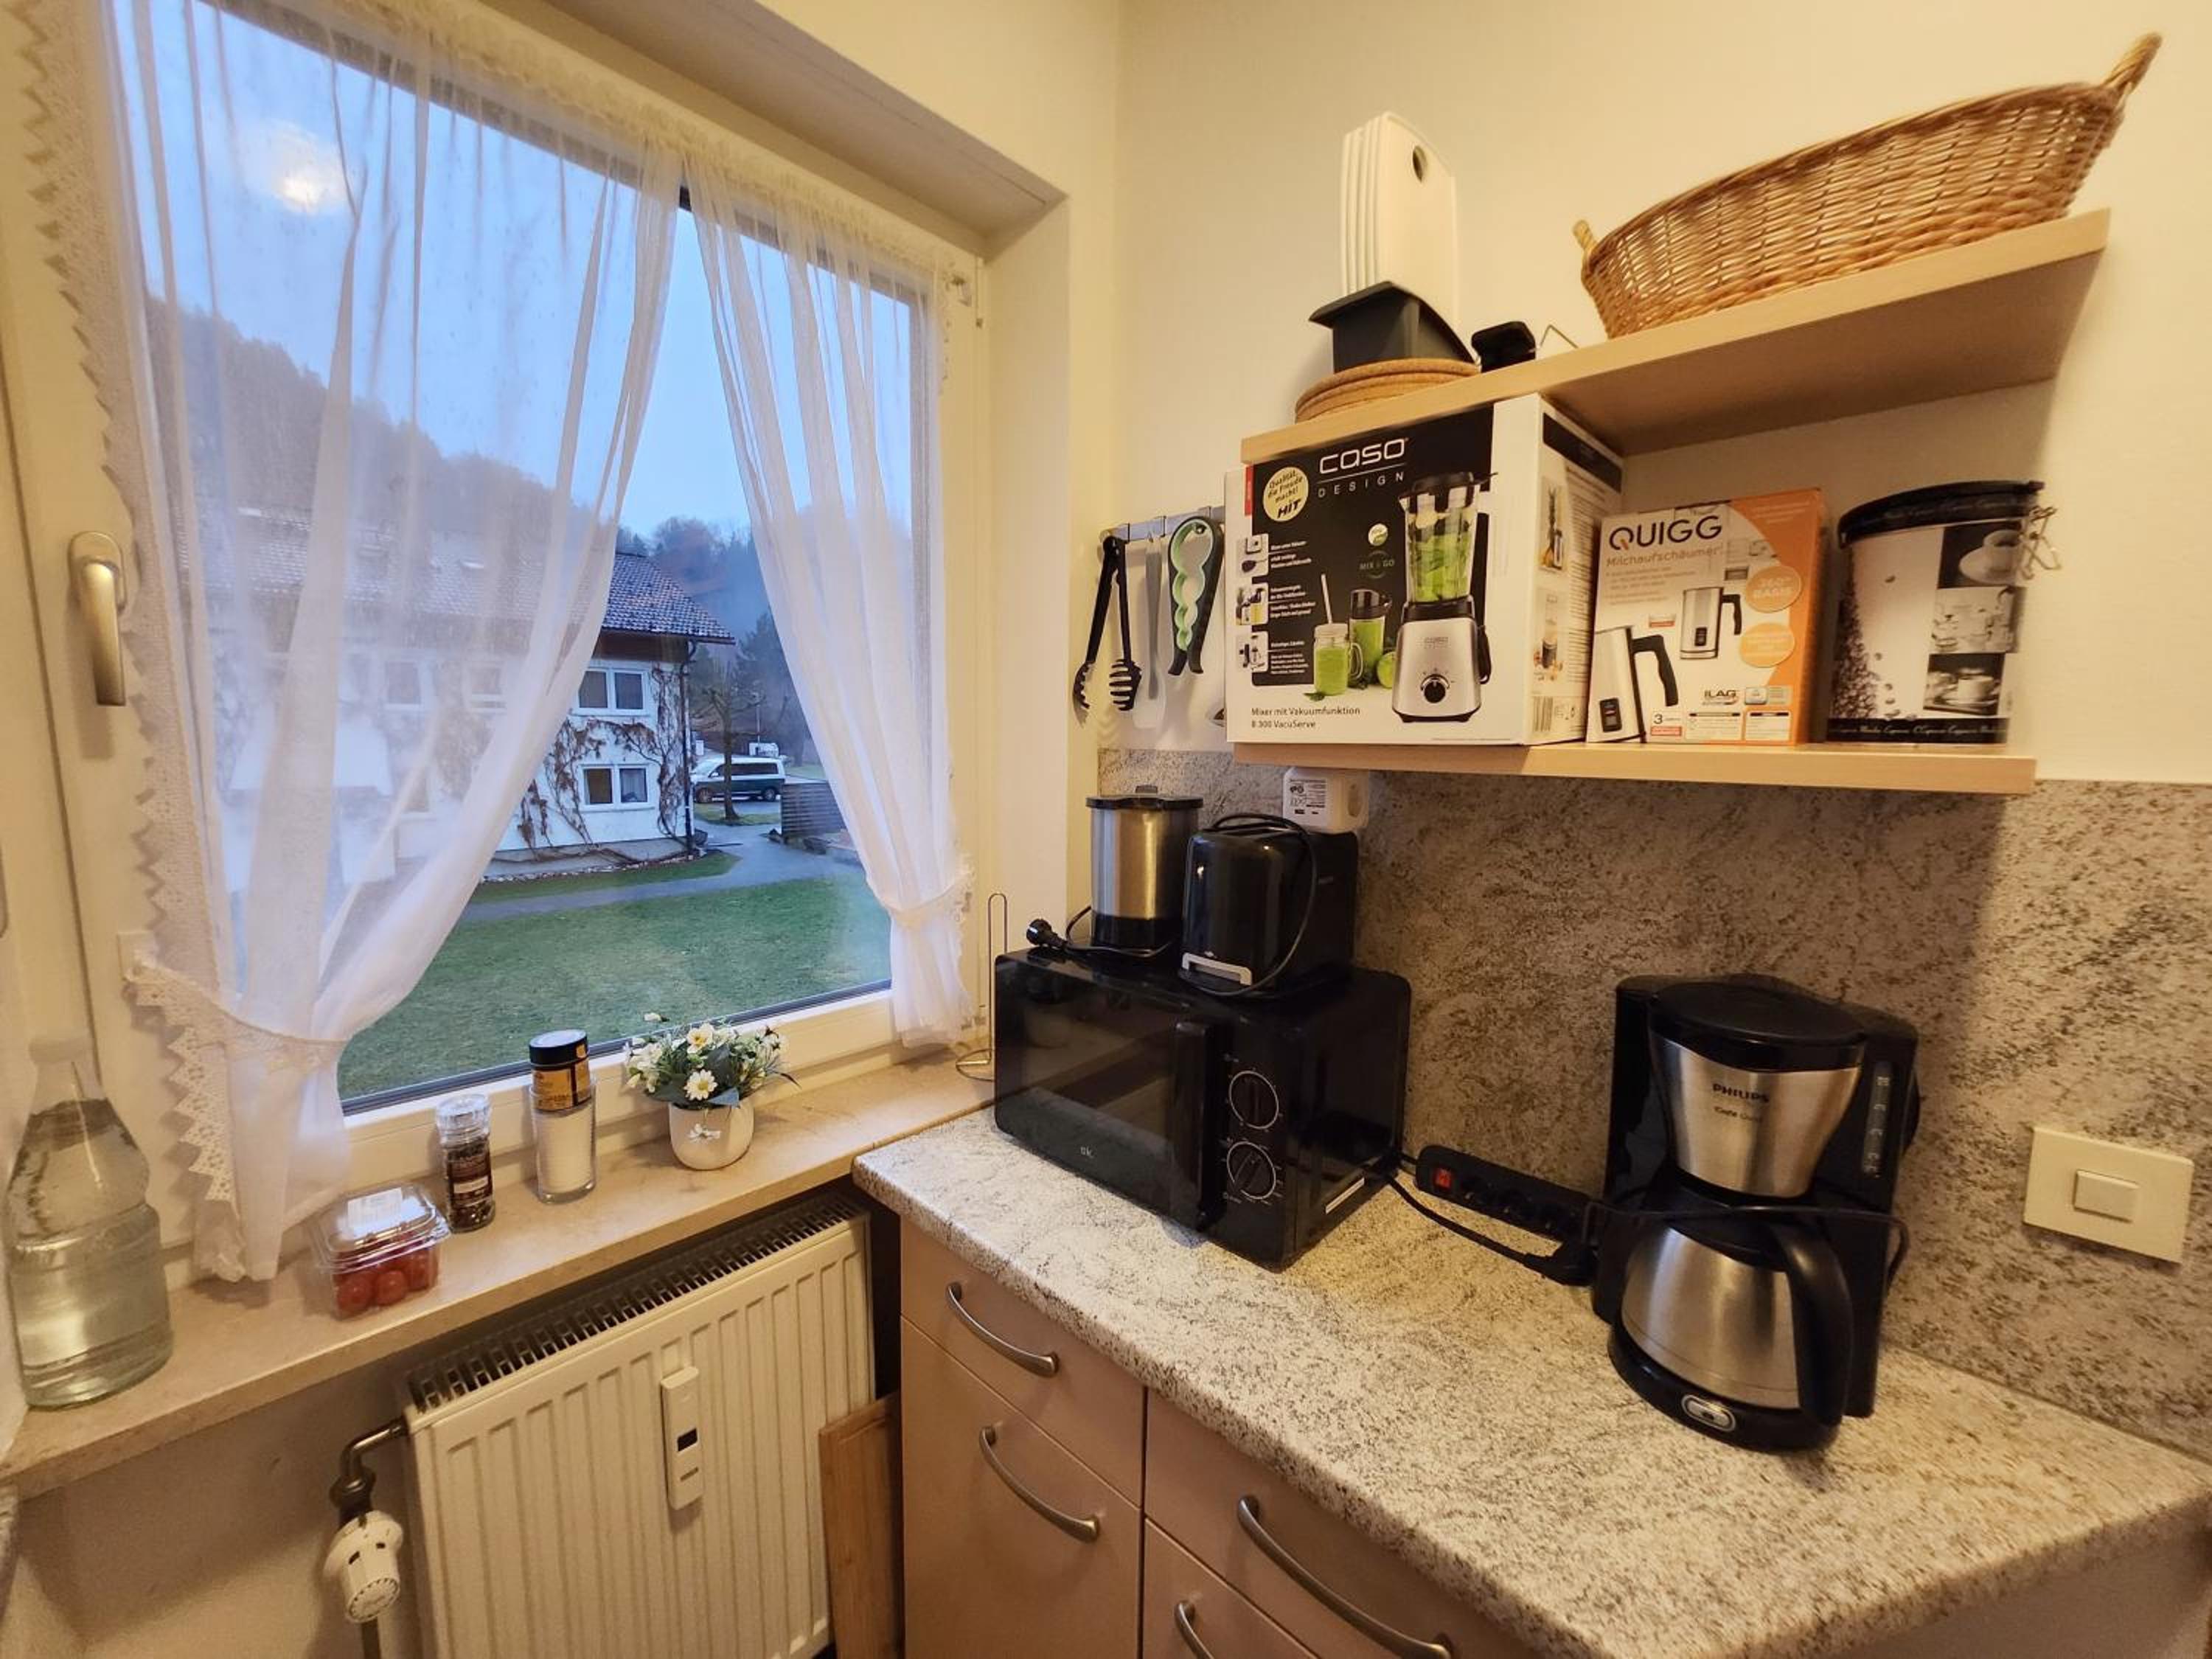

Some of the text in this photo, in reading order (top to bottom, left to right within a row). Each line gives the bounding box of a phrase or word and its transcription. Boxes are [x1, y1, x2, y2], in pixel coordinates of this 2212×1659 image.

[1317, 471, 1405, 498] DESIGN
[1276, 498, 1301, 519] HIT
[1609, 515, 1722, 551] QUIGG
[1274, 707, 1288, 716] mit
[1288, 705, 1361, 716] Vakuumfunktion
[1653, 714, 1663, 725] 3
[1712, 1082, 1770, 1103] PHILIPS
